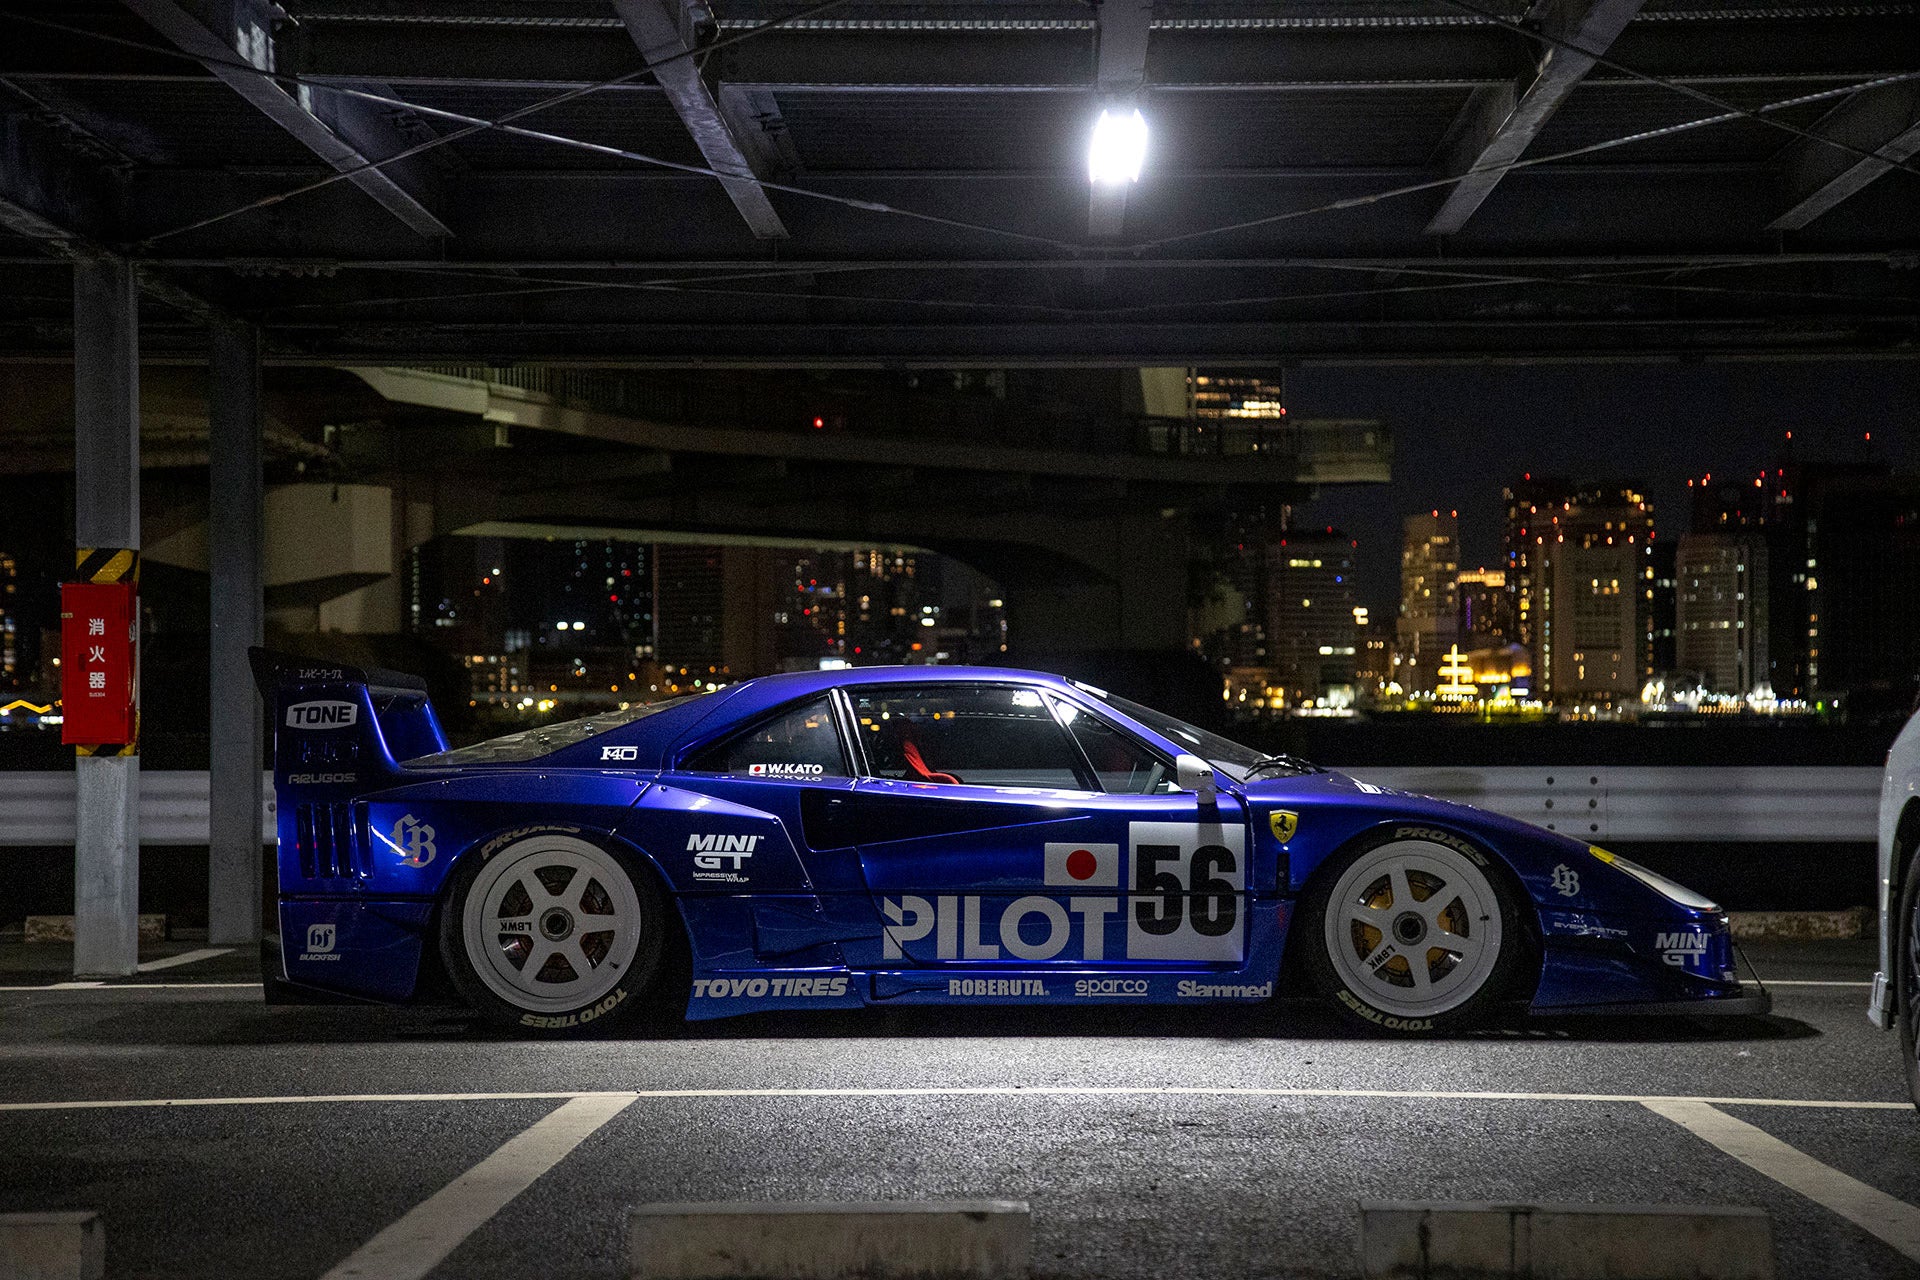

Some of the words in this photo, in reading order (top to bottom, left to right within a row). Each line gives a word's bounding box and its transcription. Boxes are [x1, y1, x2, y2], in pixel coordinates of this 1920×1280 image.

[88, 618, 106, 689] 消火器
[293, 705, 352, 724] TONE
[600, 746, 638, 761] F40
[768, 763, 823, 775] W.KATO
[288, 773, 357, 785] ARUGOS
[686, 834, 758, 851] MINI
[1395, 827, 1490, 867] PROXES
[694, 852, 753, 870] GT
[1135, 845, 1238, 937] 56
[500, 922, 532, 931] LBWK
[883, 896, 1119, 960] PILOT
[1655, 933, 1711, 949] MINI
[1367, 944, 1396, 971] LBWK
[1661, 950, 1706, 966] GT
[692, 979, 769, 998] TOYO
[769, 978, 849, 997] TIRES
[949, 980, 1044, 996] ROBERUTA
[1075, 979, 1148, 997] sparco
[1177, 980, 1272, 998] Slammed
[580, 988, 628, 1025] TOYO
[1336, 989, 1384, 1025] TIRES
[520, 1013, 578, 1029] TIRES
[1382, 1017, 1434, 1032] TOYO
